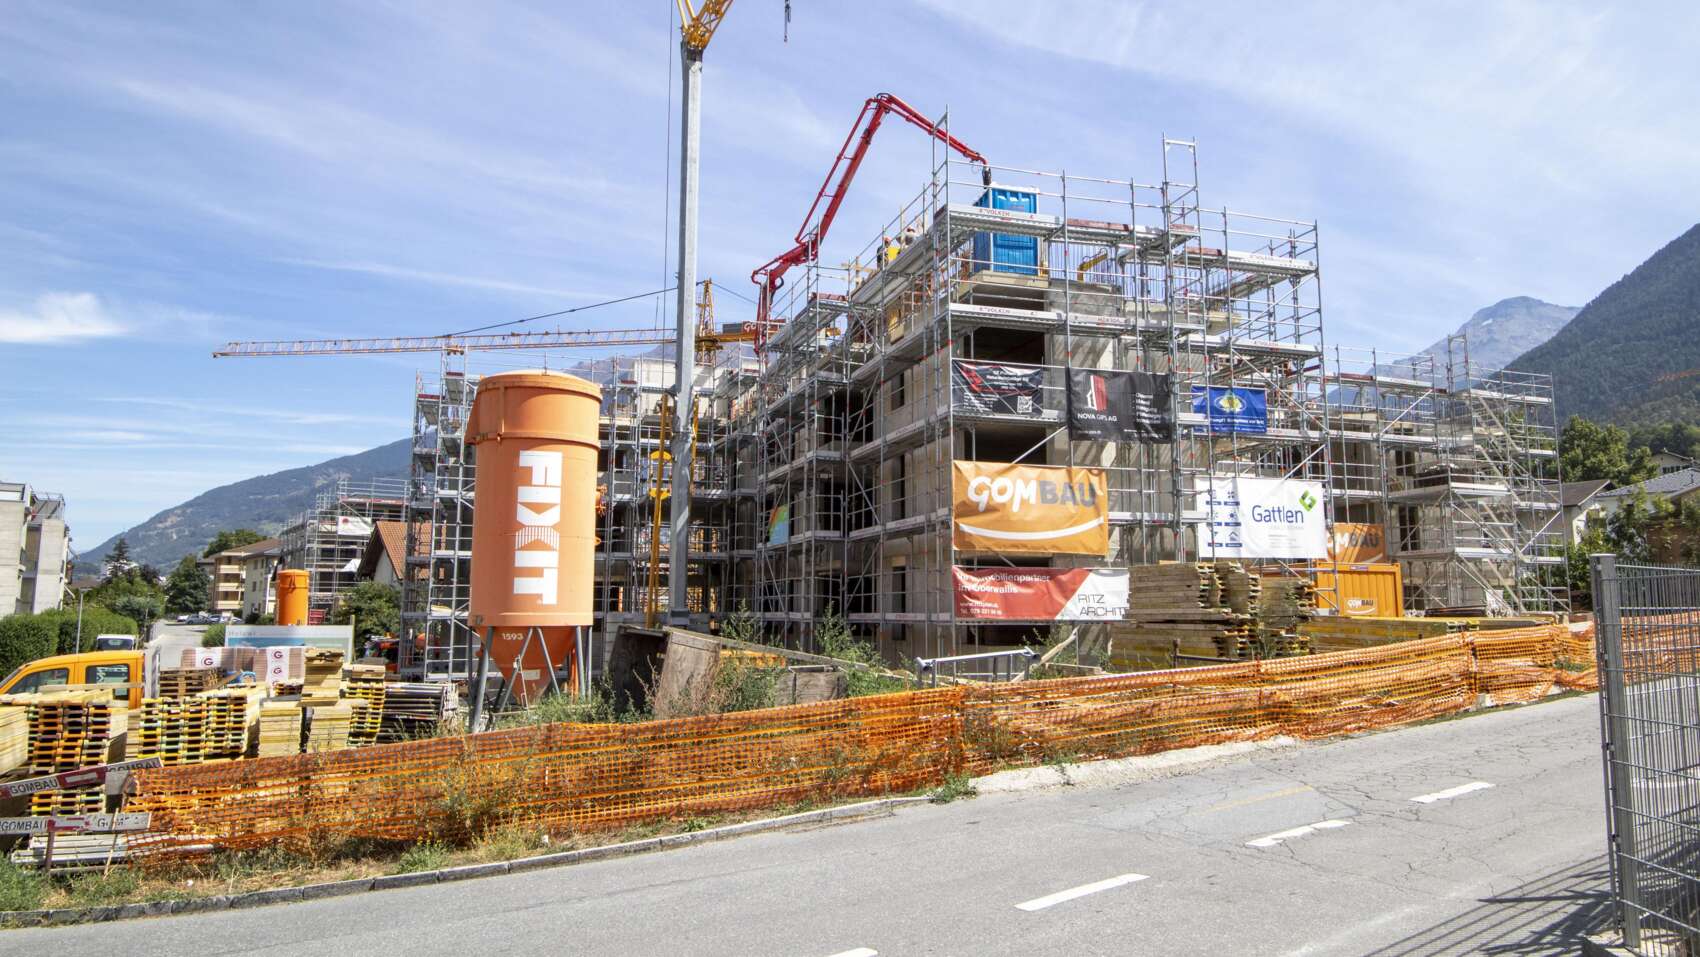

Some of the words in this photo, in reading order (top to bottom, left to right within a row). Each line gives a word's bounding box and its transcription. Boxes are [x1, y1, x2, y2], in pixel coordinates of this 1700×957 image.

[967, 476, 1099, 513] GOMBAU
[1251, 504, 1304, 524] Gattlen
[513, 451, 562, 605] FIXIT
[1078, 593, 1105, 604] RITZ
[1079, 606, 1129, 616] ARCHIT
[502, 632, 524, 641] 1593
[9, 778, 59, 795] GOMBAU
